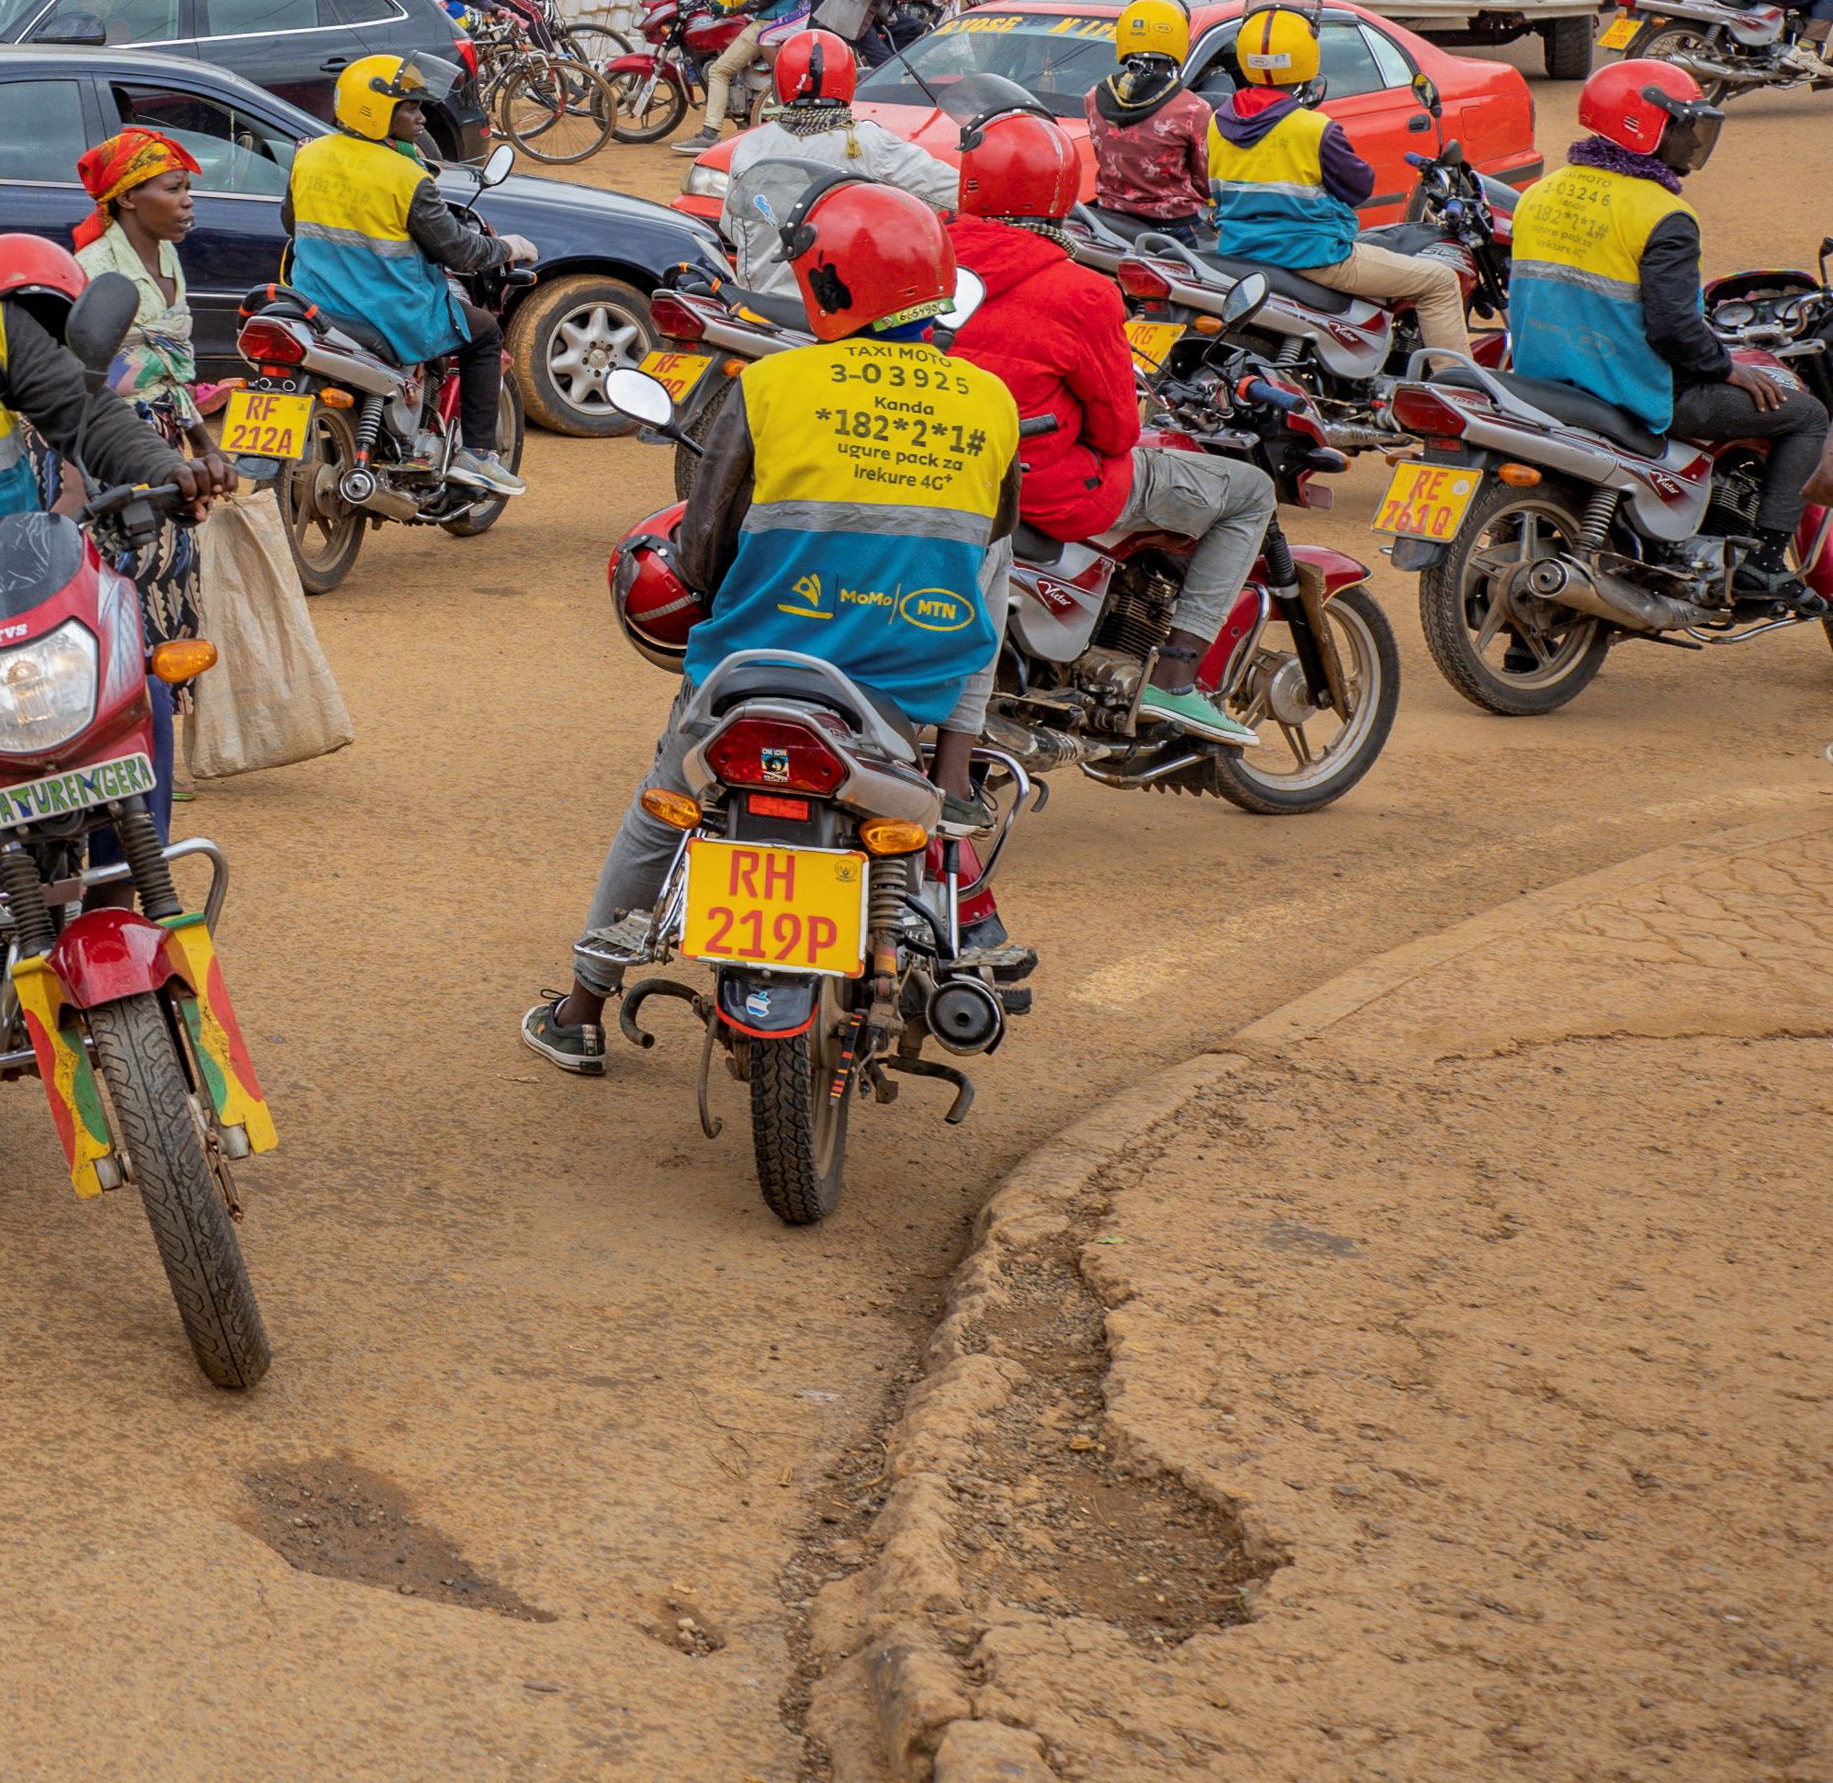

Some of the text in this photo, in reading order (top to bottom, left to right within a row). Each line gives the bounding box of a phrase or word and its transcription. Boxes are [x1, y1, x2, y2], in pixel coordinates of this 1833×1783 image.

[1577, 173, 1613, 188] MOTO
[1559, 198, 1586, 211] anda
[1130, 325, 1159, 345] RG
[651, 354, 688, 373] RF
[845, 346, 952, 368] TAXI MOTO
[830, 362, 970, 395] 3-03925
[245, 394, 281, 421] RF
[874, 395, 935, 416] Kanda
[229, 423, 293, 453] 212A
[837, 442, 964, 471] ugure pack za
[1408, 469, 1449, 501] RE
[1650, 470, 1680, 494] Victor
[1381, 500, 1452, 536] 761Q
[840, 588, 958, 620] MoMo MTN
[1038, 580, 1072, 606] Victor
[728, 849, 797, 903] RH
[704, 906, 838, 964] 219P
